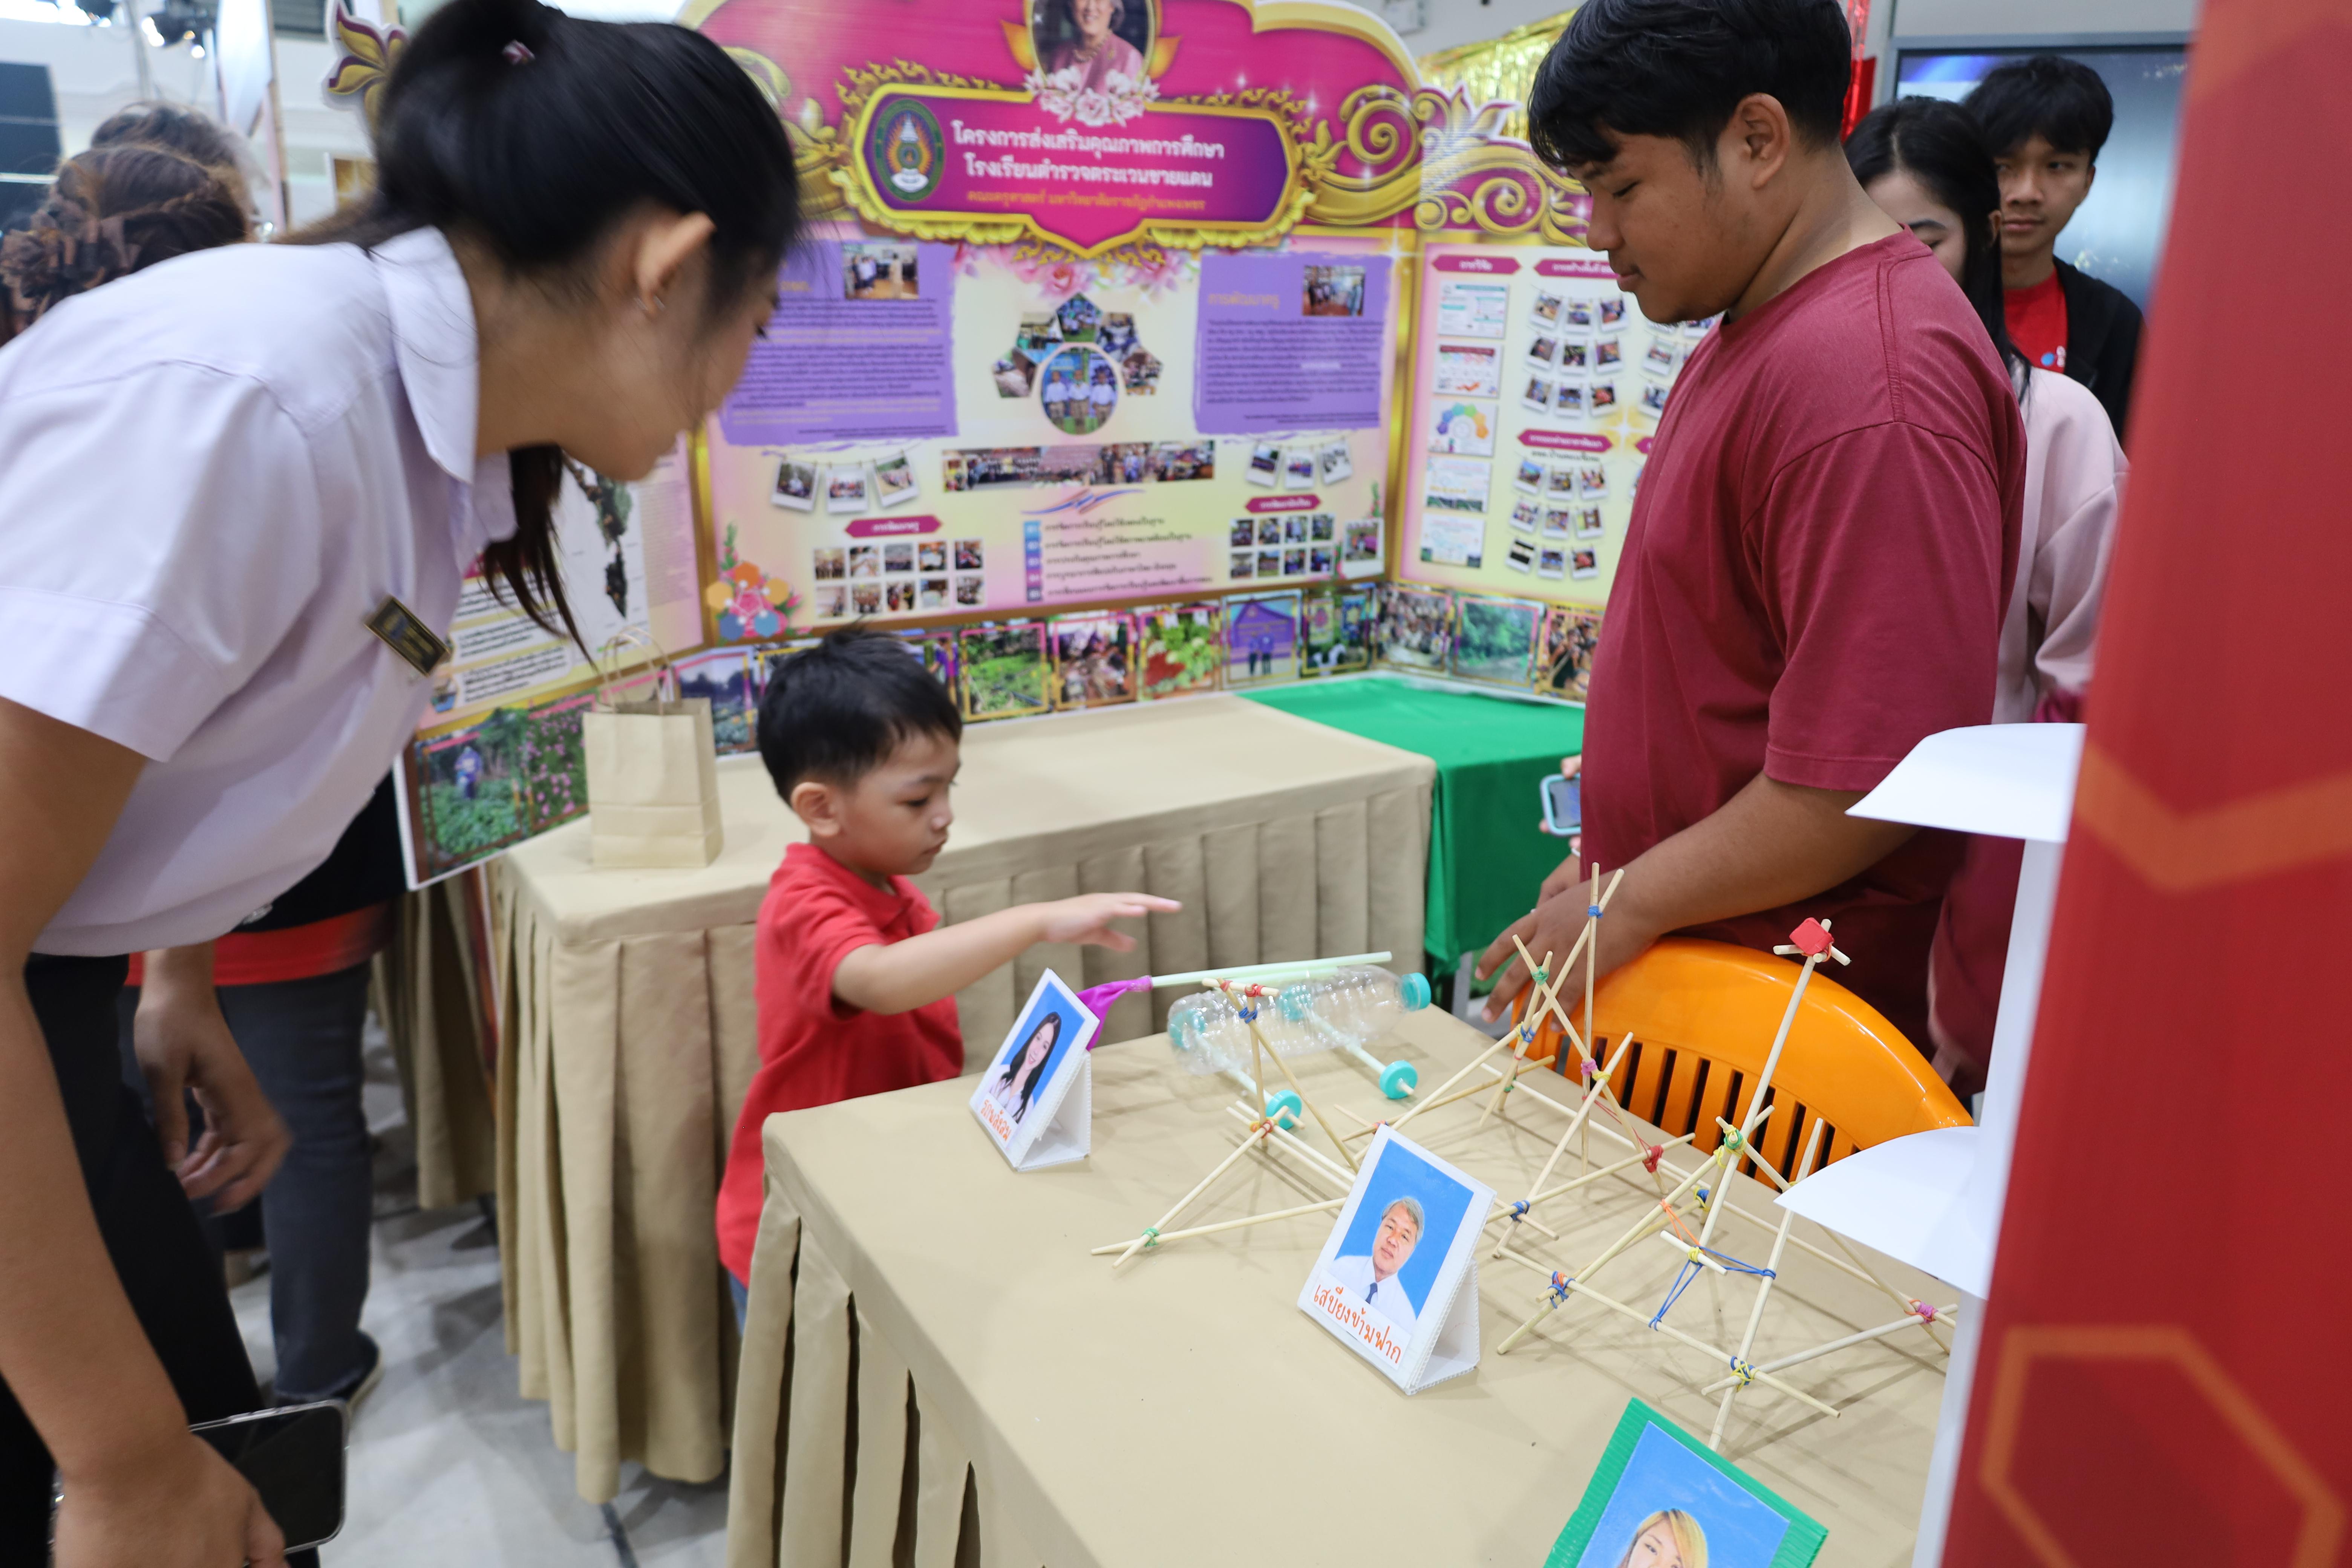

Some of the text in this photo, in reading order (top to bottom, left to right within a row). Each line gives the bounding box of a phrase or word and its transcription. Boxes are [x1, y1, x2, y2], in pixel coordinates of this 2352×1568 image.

[951, 119, 1225, 160] โครงการส่งเสริมคุณภาพการศึกษา
[963, 152, 1213, 188] โรงเรียนตำรวจตระเวนชายแดน
[1314, 1285, 1401, 1364] เสบียงข้ามฟาก
